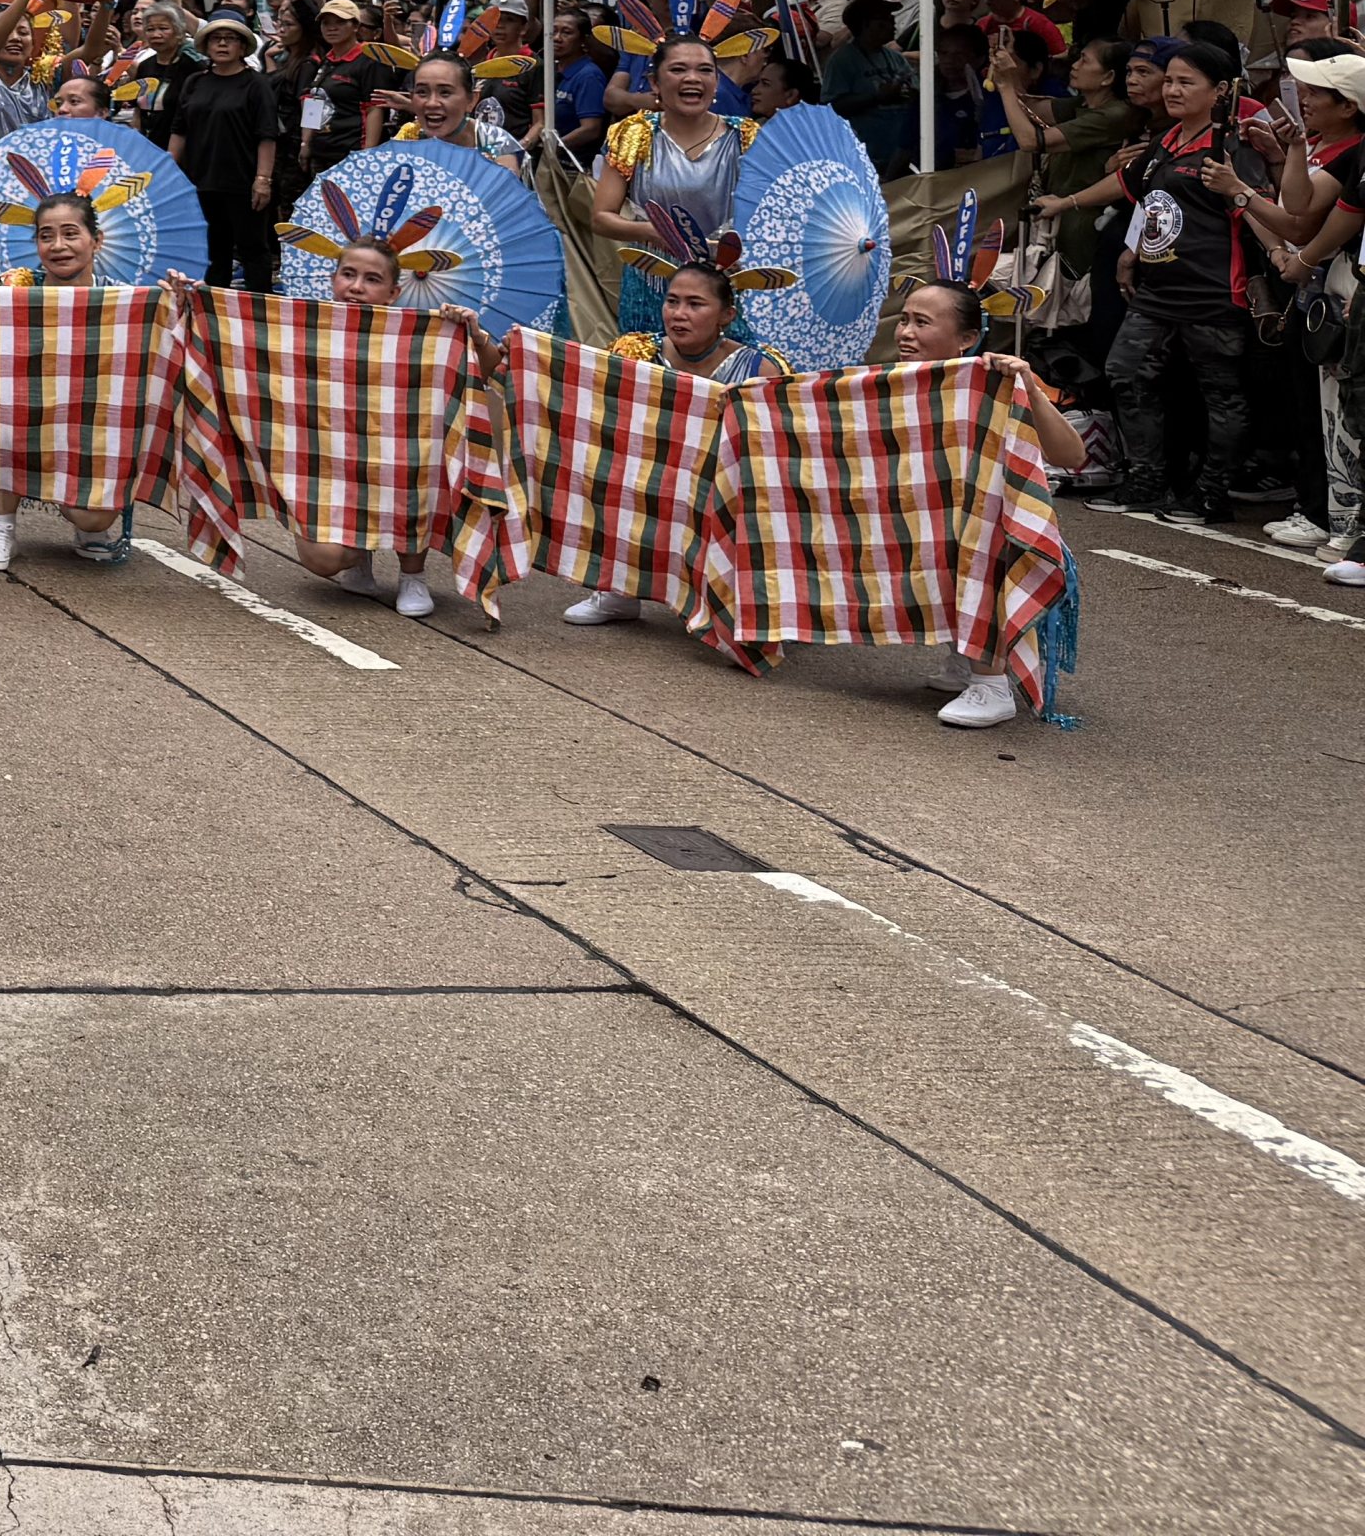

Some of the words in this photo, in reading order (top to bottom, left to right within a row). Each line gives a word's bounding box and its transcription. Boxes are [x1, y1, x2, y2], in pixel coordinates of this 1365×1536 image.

[60, 135, 72, 185] LUFOH
[374, 167, 411, 233] LUFOH
[955, 191, 974, 273] LUFOH
